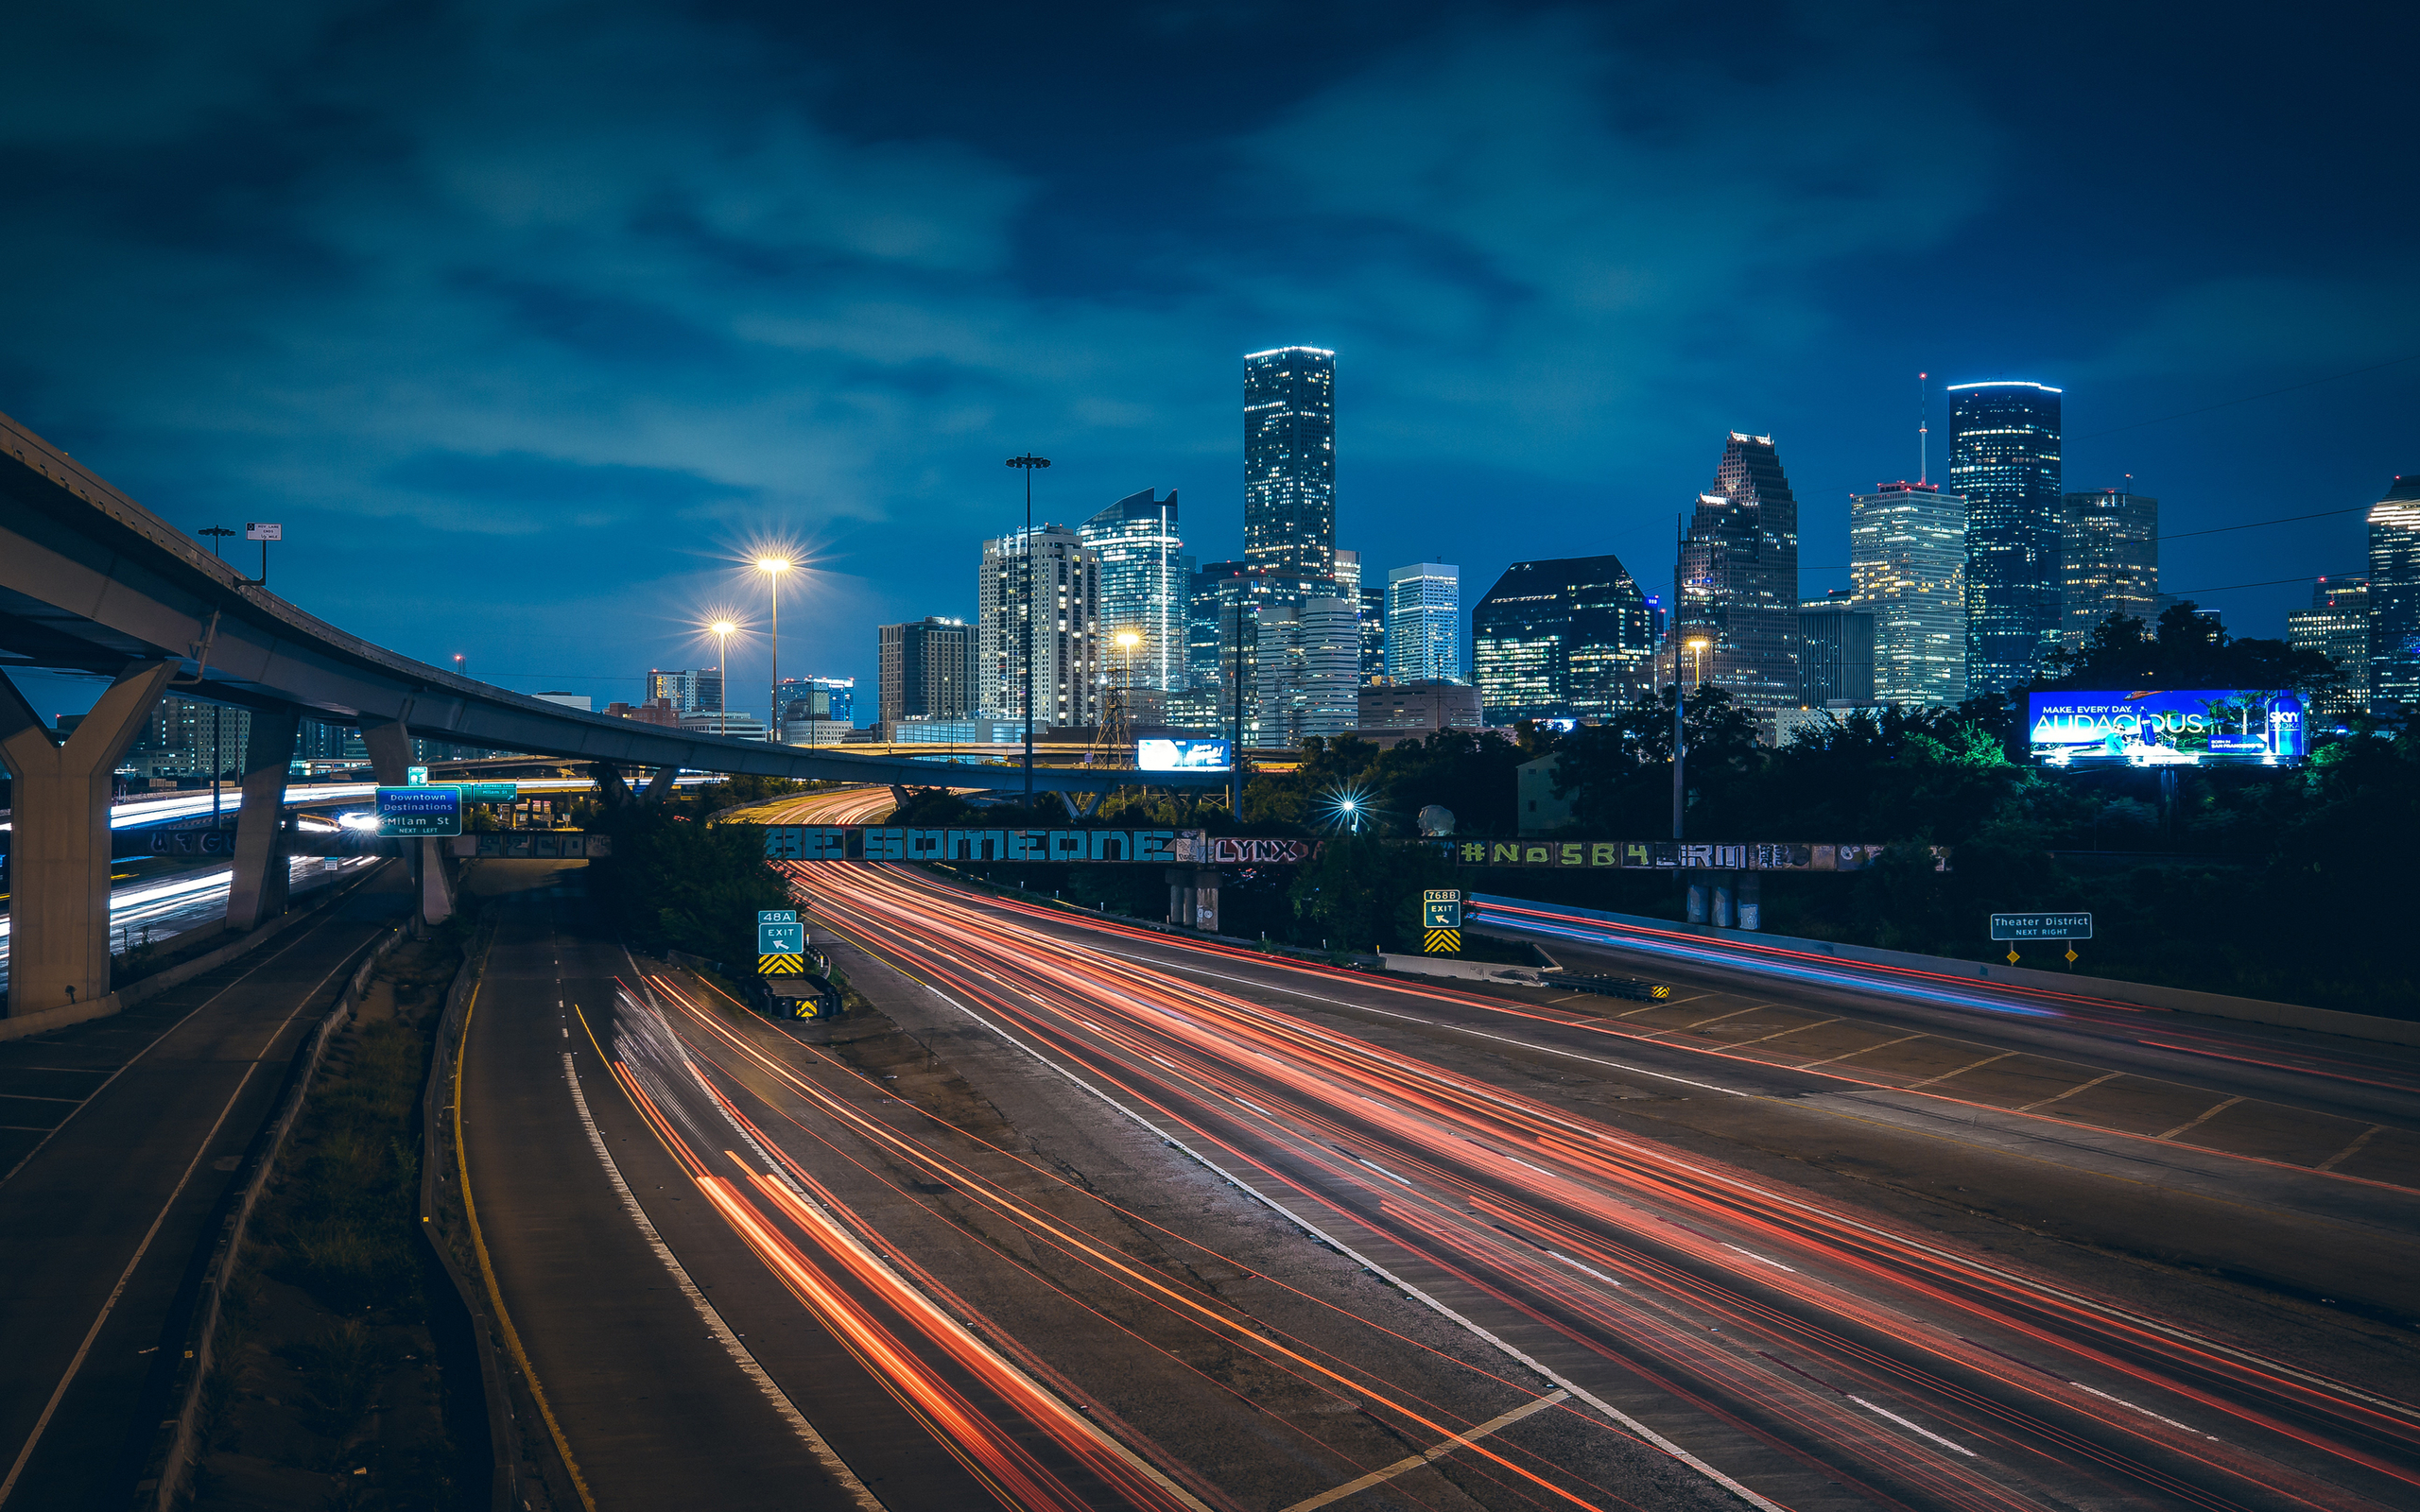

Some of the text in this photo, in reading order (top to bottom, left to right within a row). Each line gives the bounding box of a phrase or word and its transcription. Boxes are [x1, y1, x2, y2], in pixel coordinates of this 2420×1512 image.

[2269, 712, 2301, 723] SKYY
[2032, 713, 2205, 733] AUDACIOUS.
[387, 816, 449, 826] Milam St
[765, 828, 843, 859] BE
[865, 828, 1175, 861] SOMEONE
[1216, 839, 1299, 863] LYNX
[1428, 891, 1457, 900] 768B
[763, 913, 792, 921] 48A
[1995, 917, 2088, 926] Theater District
[768, 928, 794, 936] EXIT
